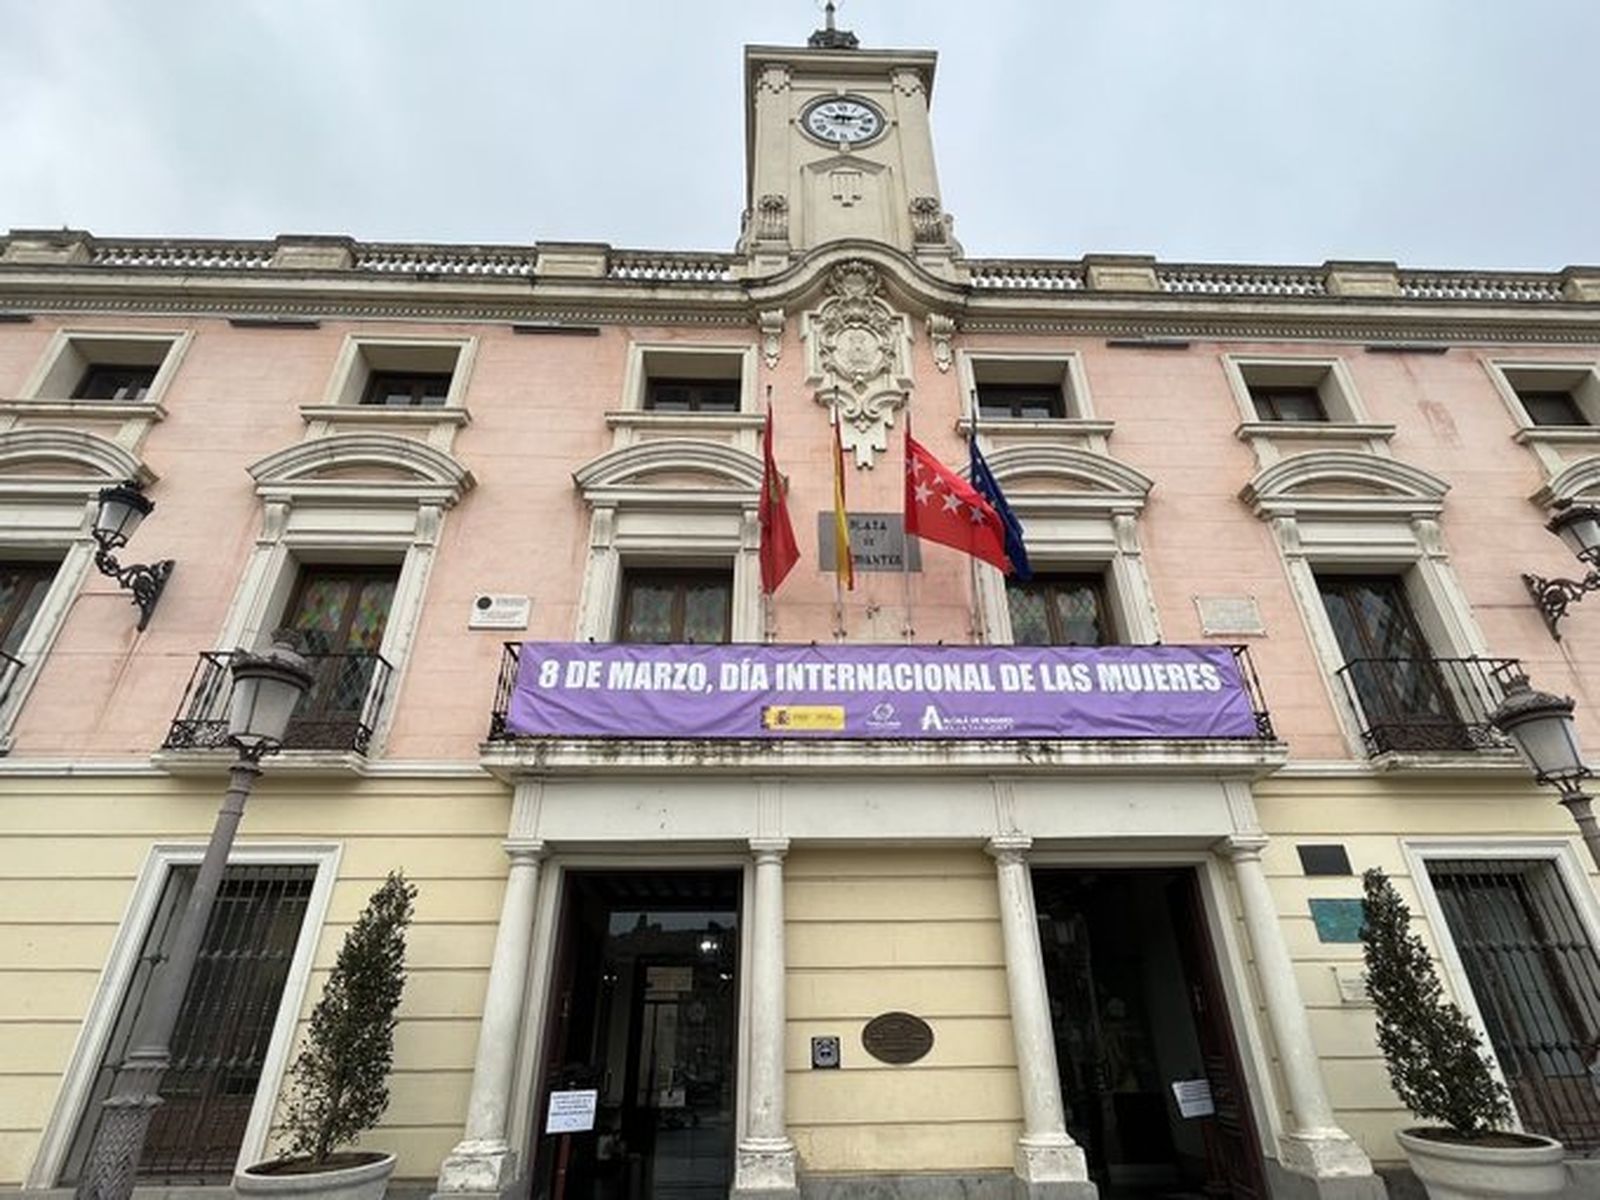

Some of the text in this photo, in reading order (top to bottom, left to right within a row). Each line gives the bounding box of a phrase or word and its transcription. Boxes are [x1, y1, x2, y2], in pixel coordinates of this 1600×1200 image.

[538, 658, 1221, 694] 8 DE MARZO, DÍA INTERNACIONAL DE LAS MUJERES
